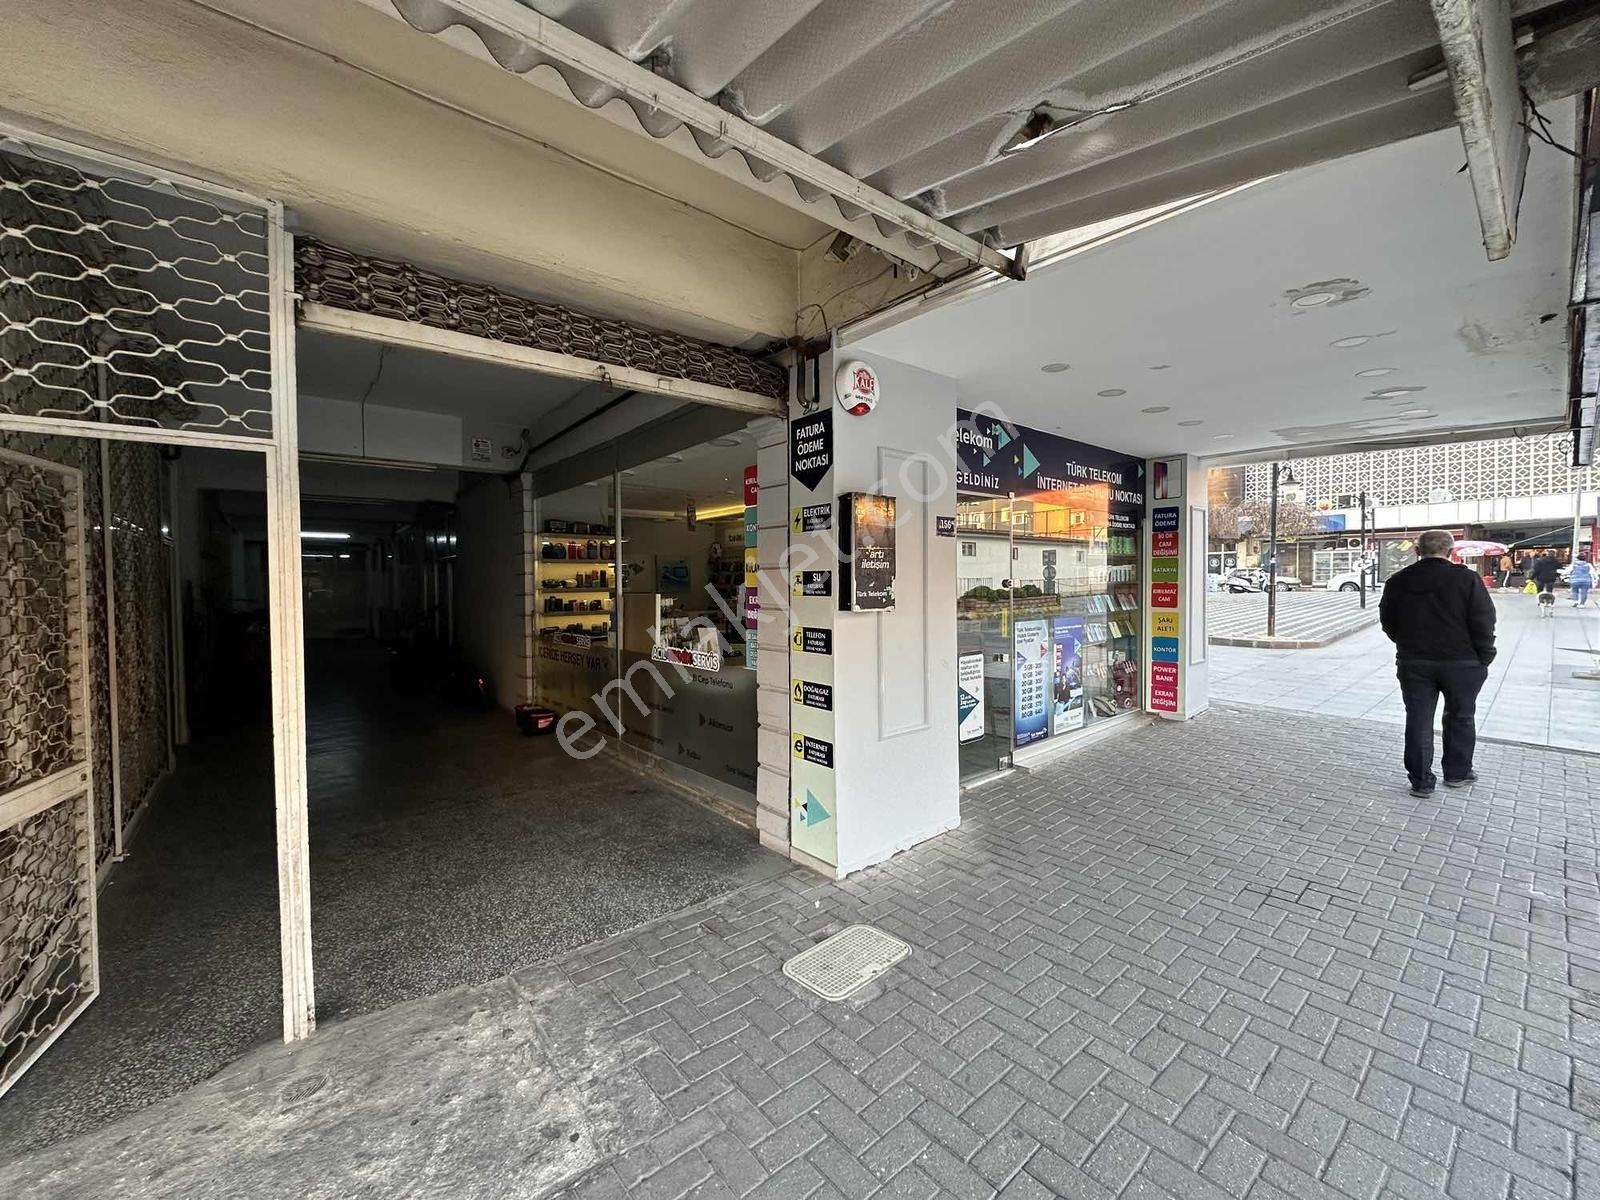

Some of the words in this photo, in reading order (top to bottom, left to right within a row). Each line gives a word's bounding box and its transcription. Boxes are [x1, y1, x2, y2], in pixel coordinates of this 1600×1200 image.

[796, 421, 825, 440] FATURA
[797, 438, 824, 456] ÖDEME
[795, 453, 829, 472] NOKTASI
[956, 471, 999, 489] GELDİNİZ
[1066, 461, 1087, 479] TÜRK
[1089, 468, 1122, 485] TELEKOM
[1115, 490, 1143, 505] NOKTASI
[861, 558, 890, 570] iletişim
[812, 573, 821, 581] SU
[692, 651, 718, 669] SERVİS
[1153, 666, 1176, 674] POWER
[1155, 674, 1173, 682] BANK
